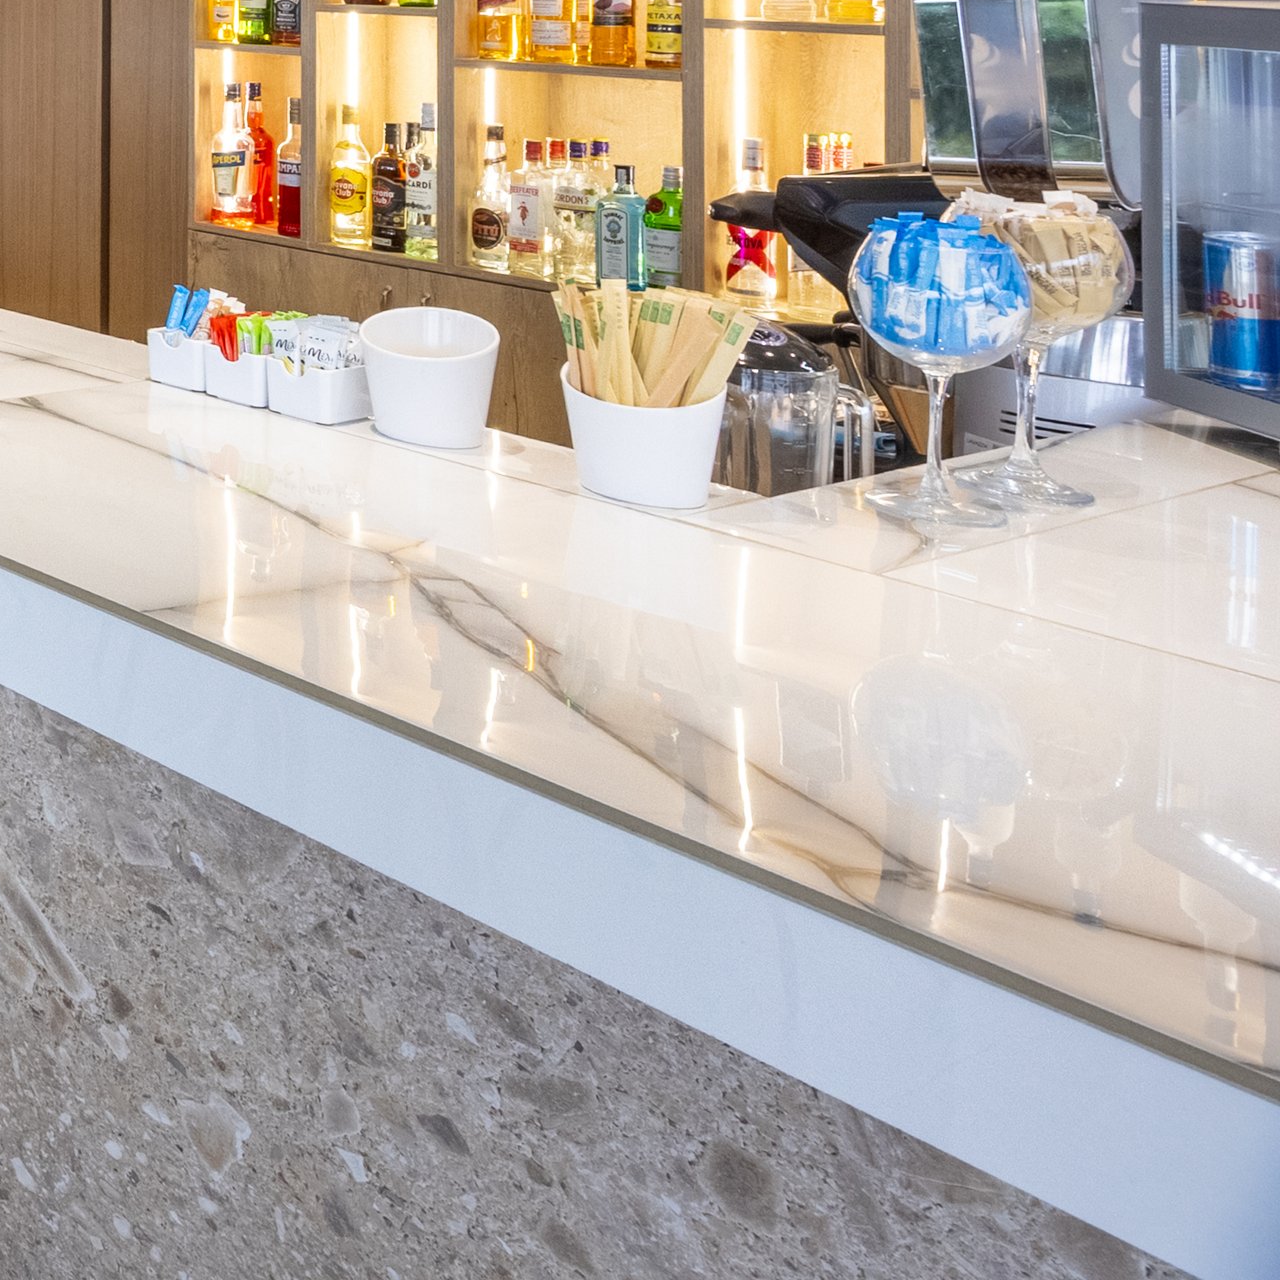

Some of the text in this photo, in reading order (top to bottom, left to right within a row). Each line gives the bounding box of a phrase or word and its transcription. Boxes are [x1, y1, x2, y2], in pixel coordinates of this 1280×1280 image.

[335, 188, 352, 197] Club
[510, 185, 539, 197] BEEFEATER
[1218, 291, 1262, 310] Bull
